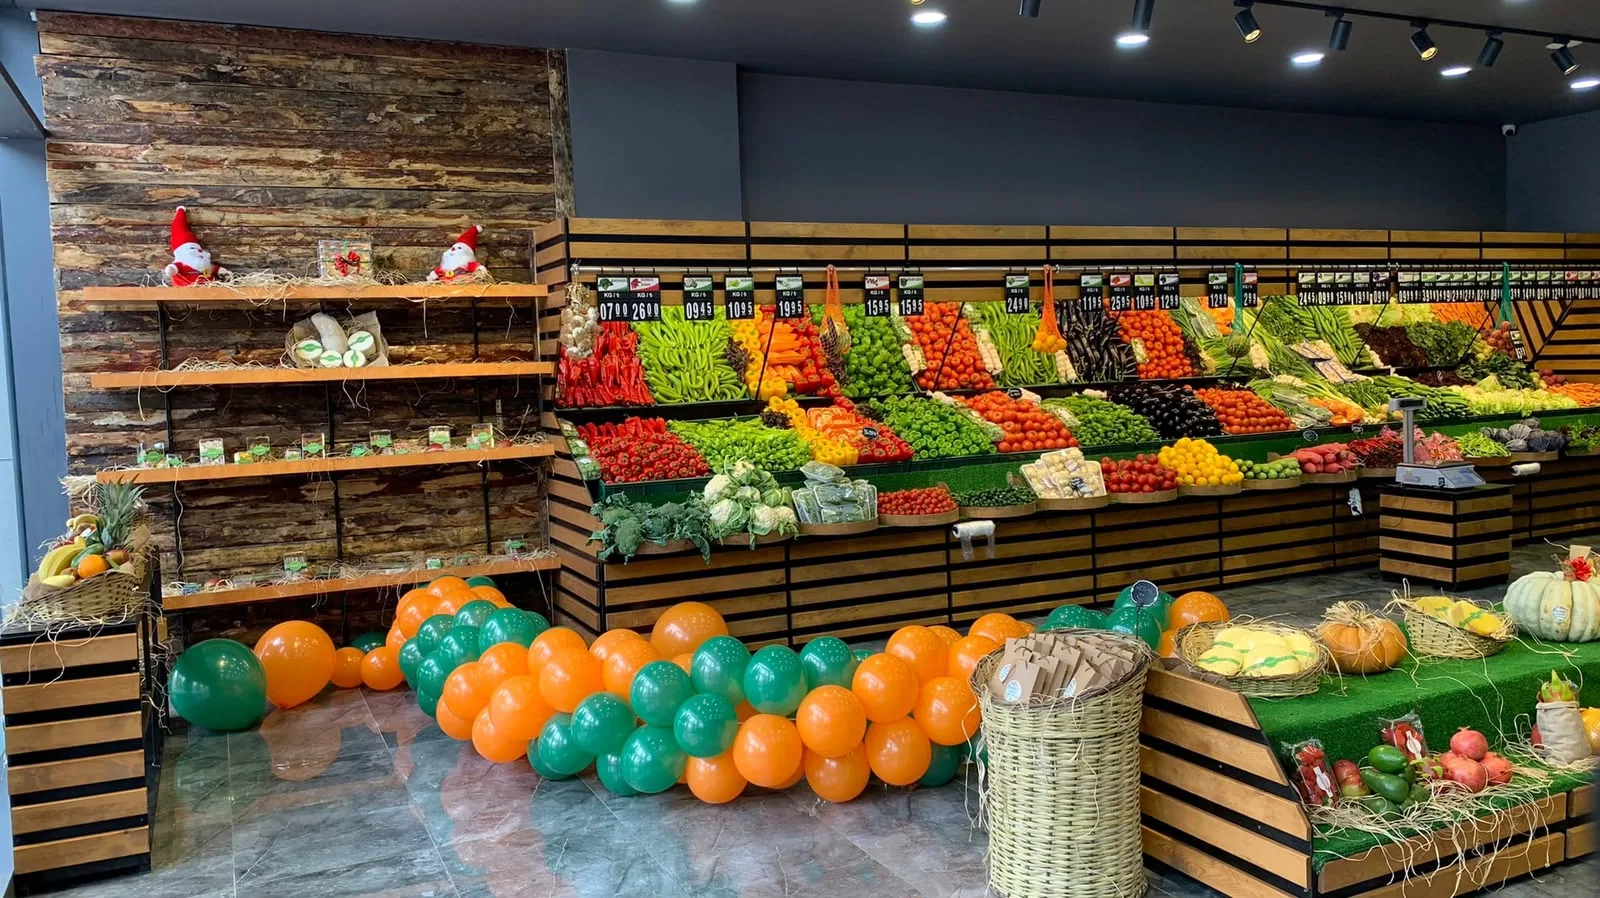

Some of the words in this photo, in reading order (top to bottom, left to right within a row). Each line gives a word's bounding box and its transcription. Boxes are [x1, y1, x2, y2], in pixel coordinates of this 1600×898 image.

[600, 302, 628, 320] 0700
[632, 302, 659, 320] 2600
[686, 302, 712, 319] 0945
[728, 301, 752, 318] 1095
[779, 300, 802, 317] 1995
